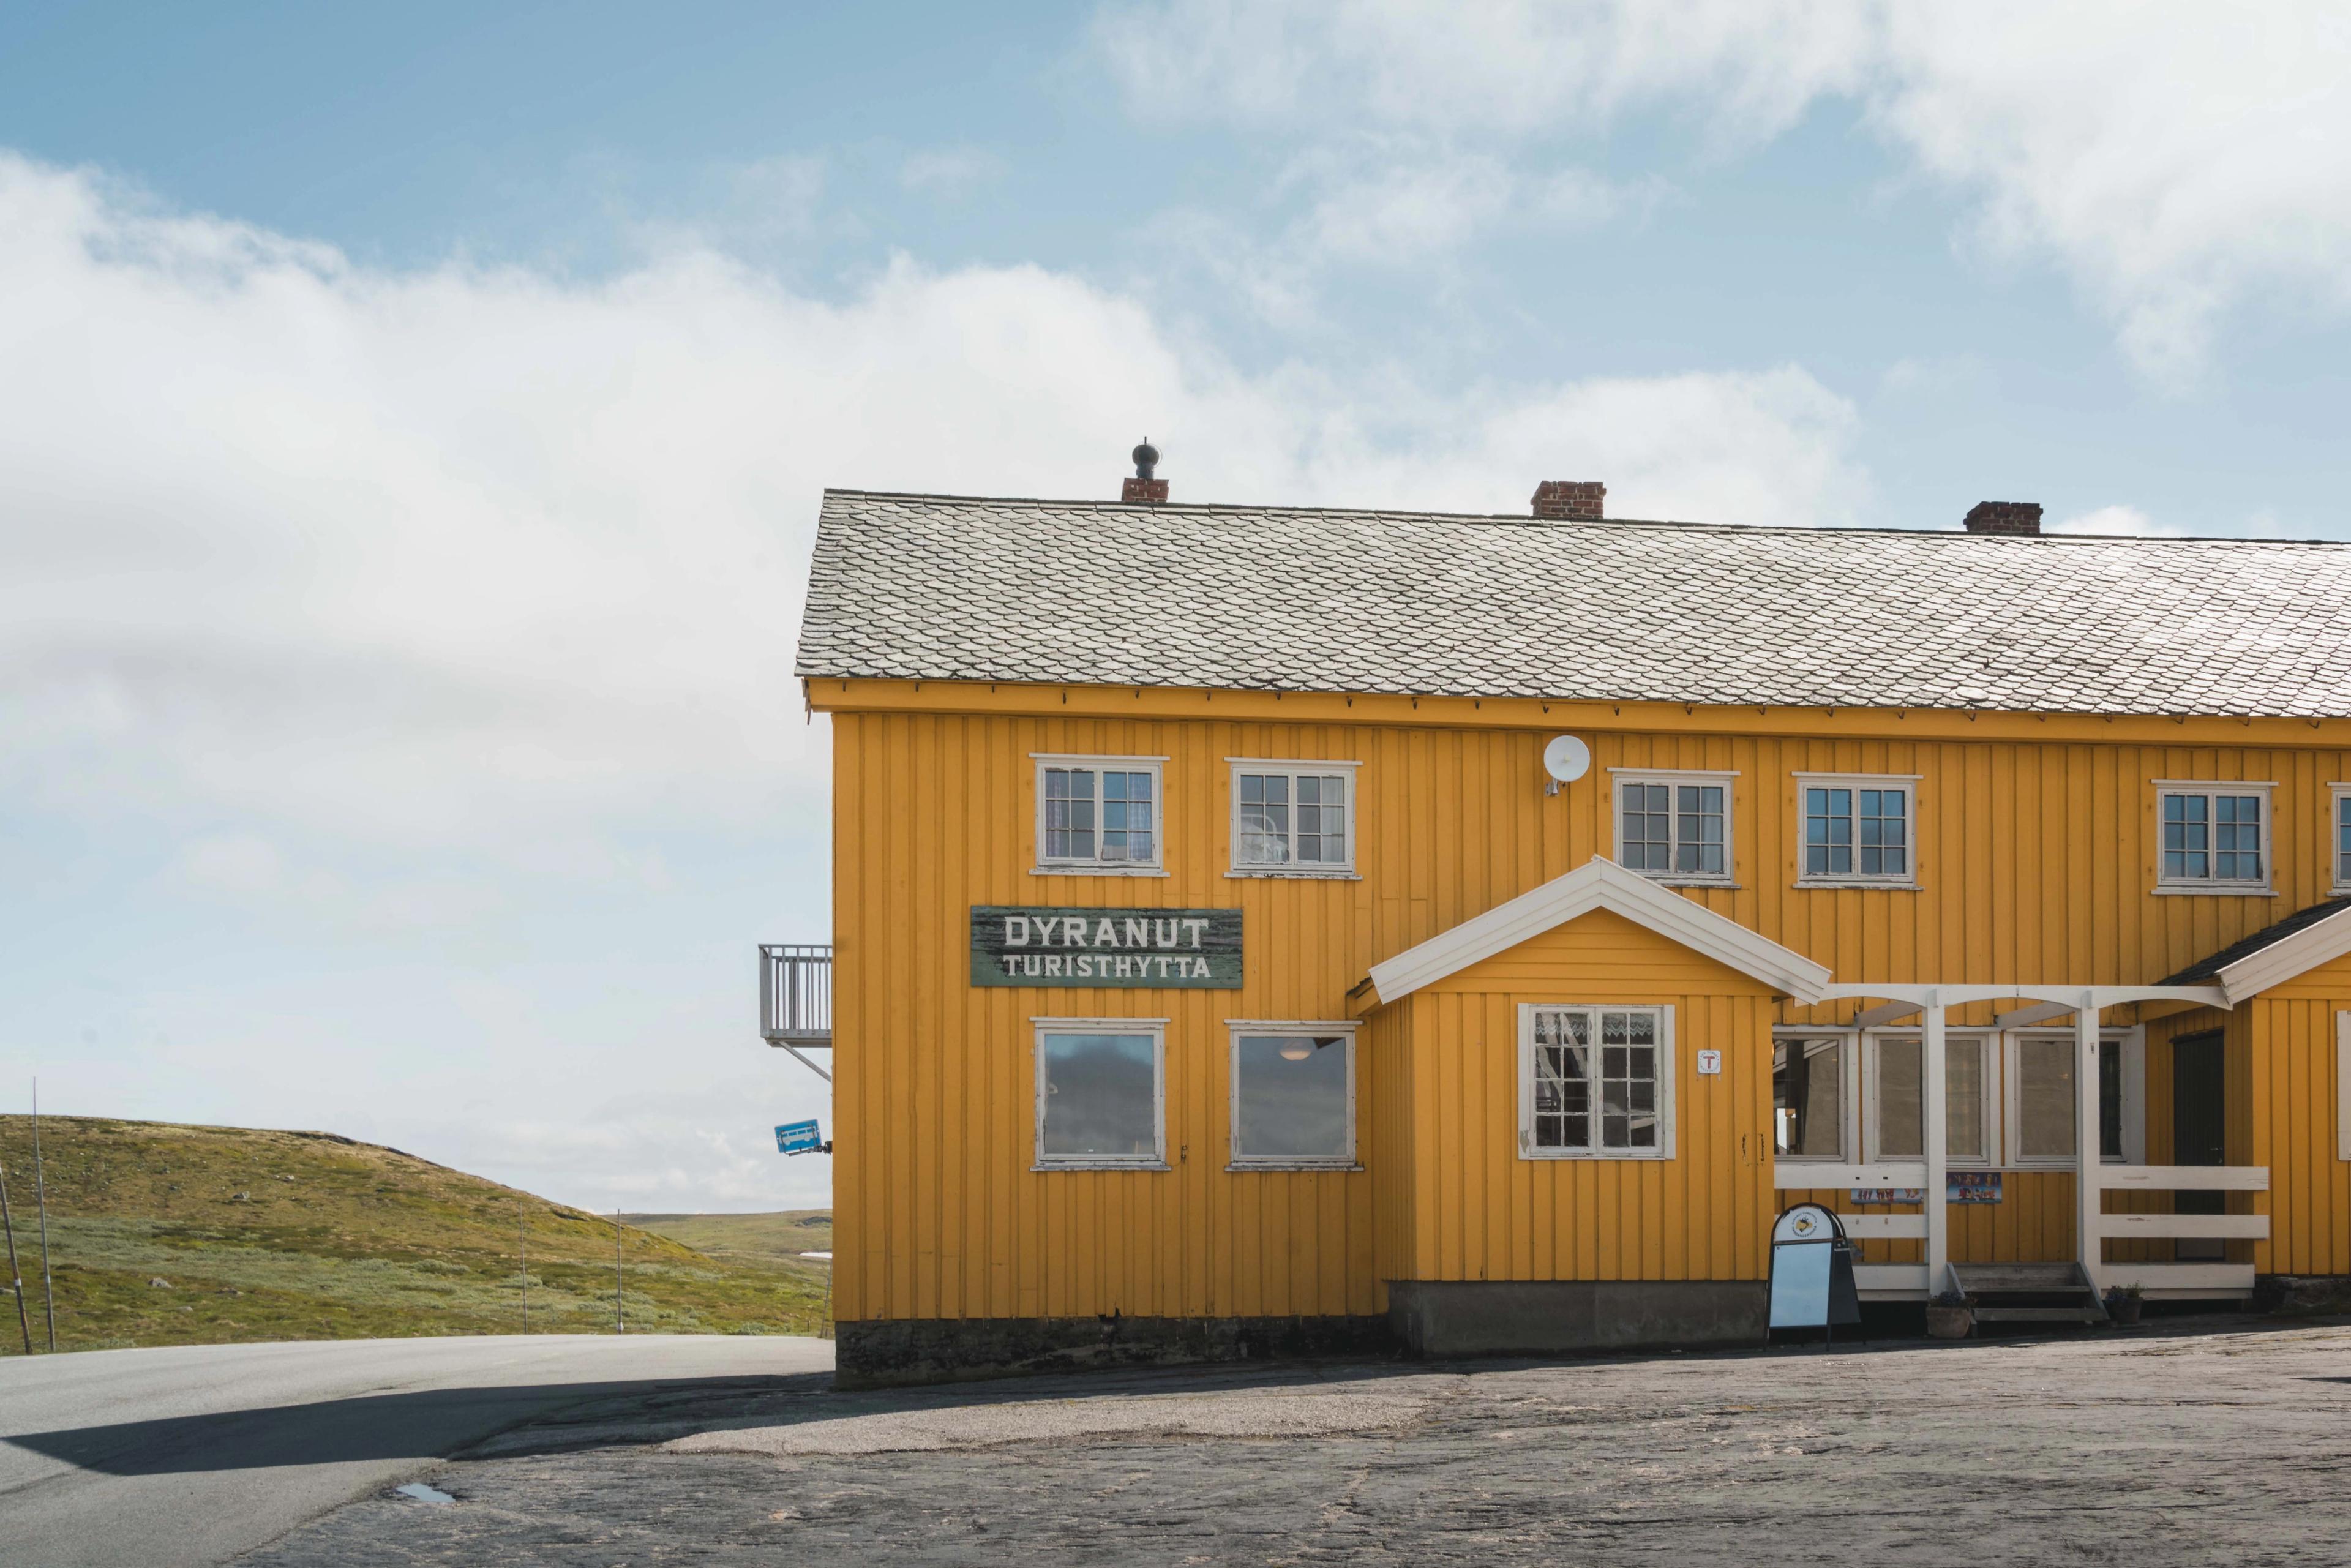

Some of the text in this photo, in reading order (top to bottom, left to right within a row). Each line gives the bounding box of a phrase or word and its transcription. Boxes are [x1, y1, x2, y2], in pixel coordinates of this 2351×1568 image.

[1004, 917, 1209, 948] DYRANUT
[1003, 955, 1212, 978] TURISTHYTTA
[1703, 1056, 1715, 1069] T
